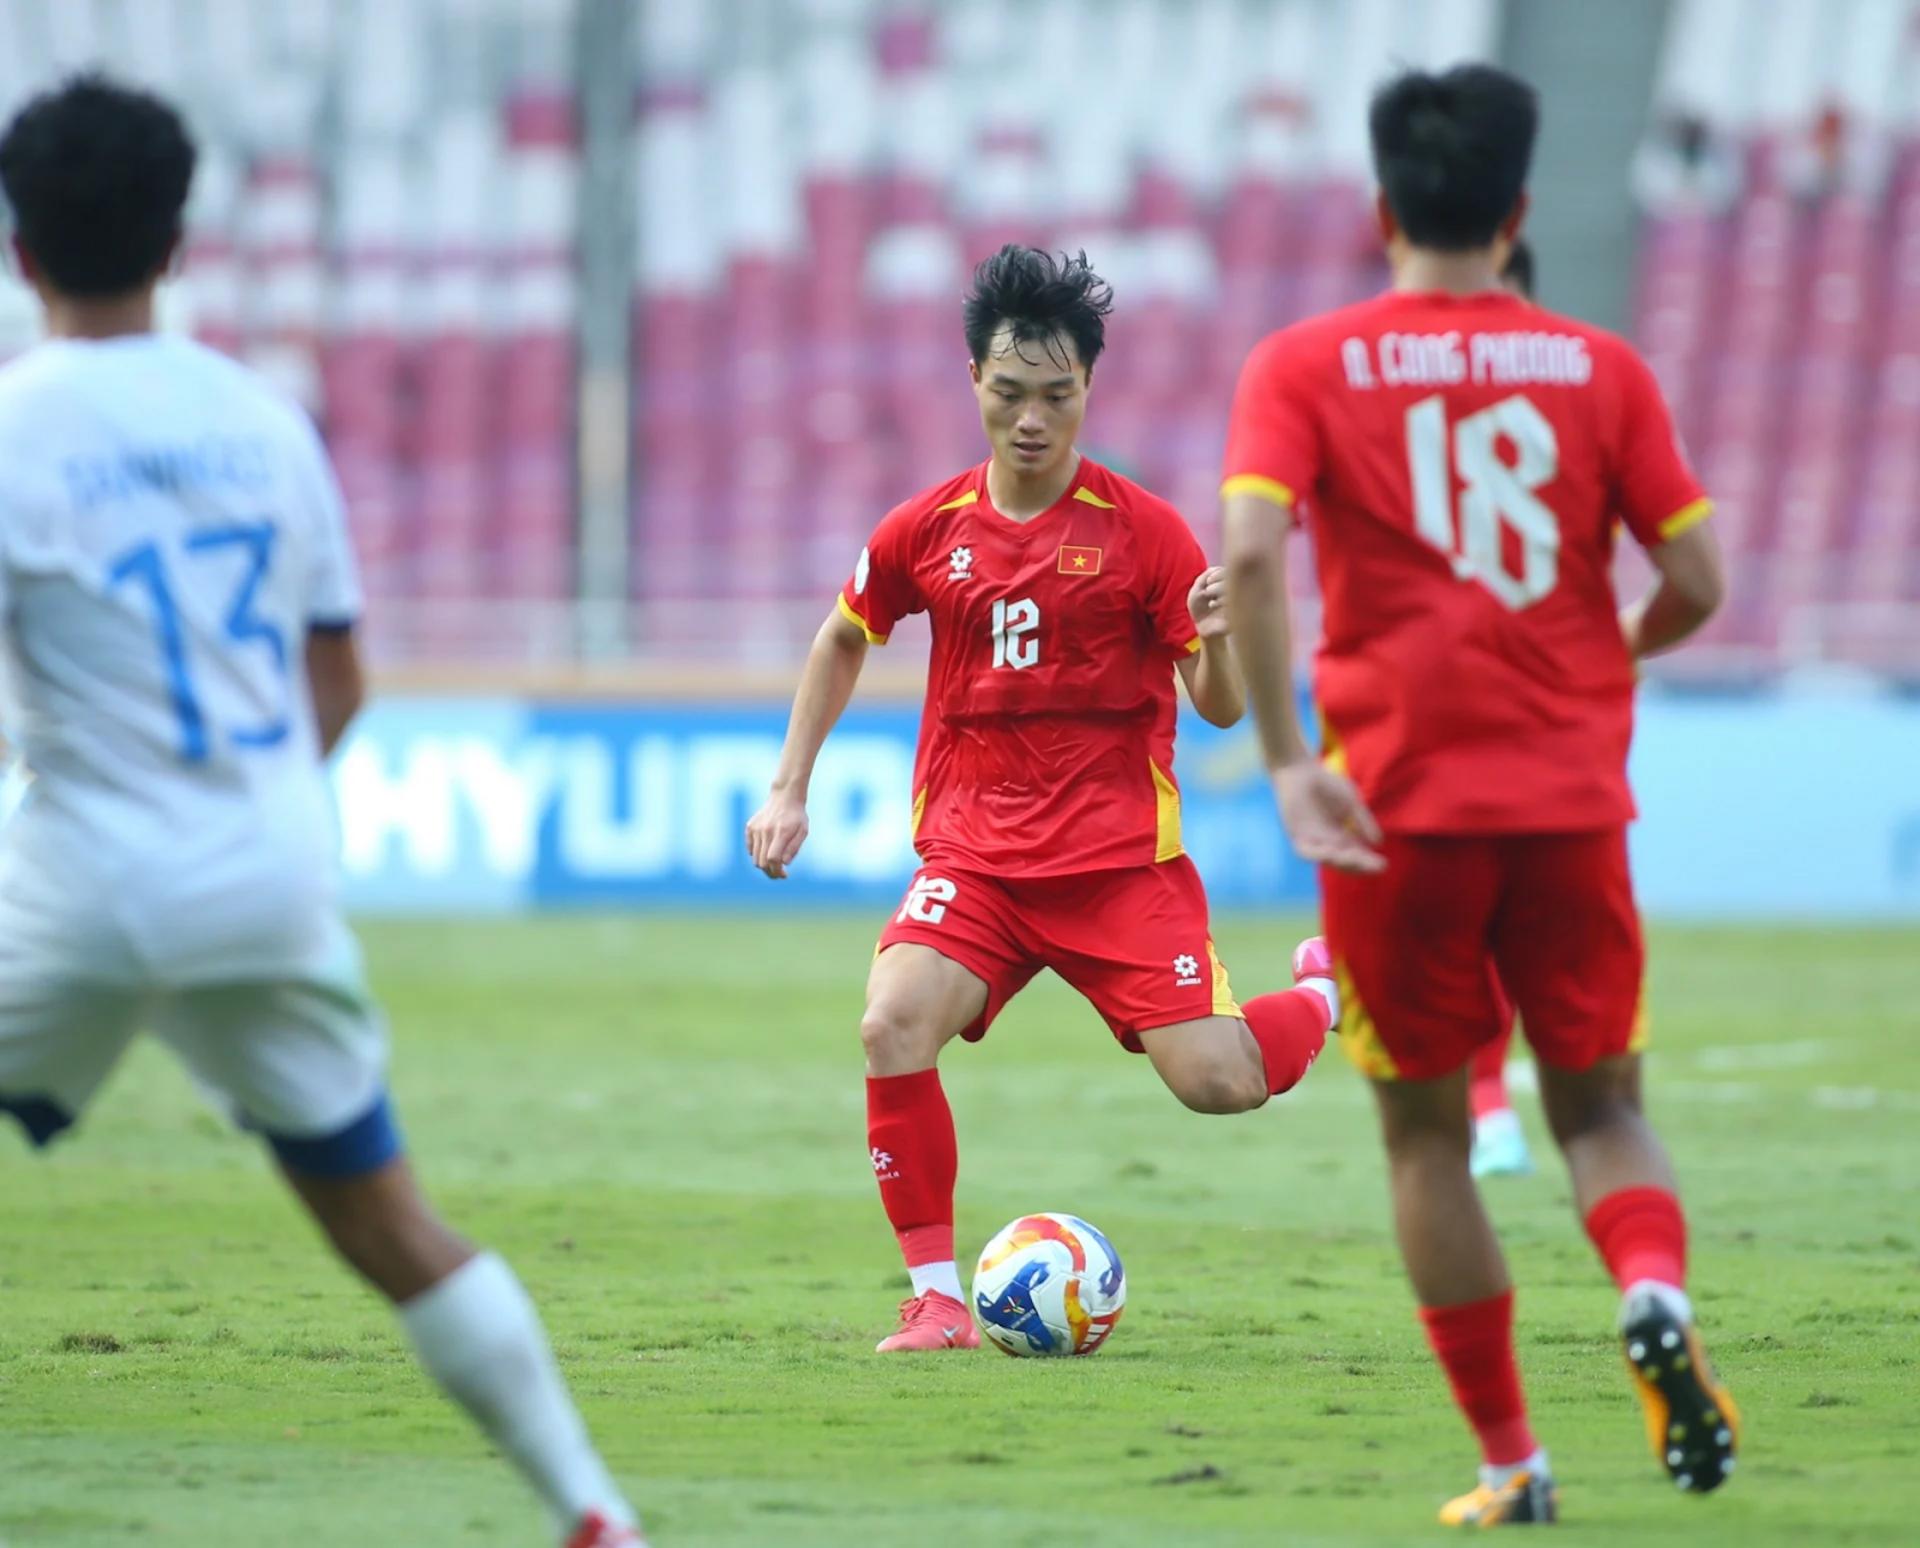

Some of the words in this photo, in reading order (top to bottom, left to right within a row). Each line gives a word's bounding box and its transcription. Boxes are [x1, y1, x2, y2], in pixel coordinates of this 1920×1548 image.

[1404, 393, 1561, 613] 18
[108, 518, 289, 765] 13
[991, 597, 1040, 670] 12
[896, 875, 958, 925] 12
